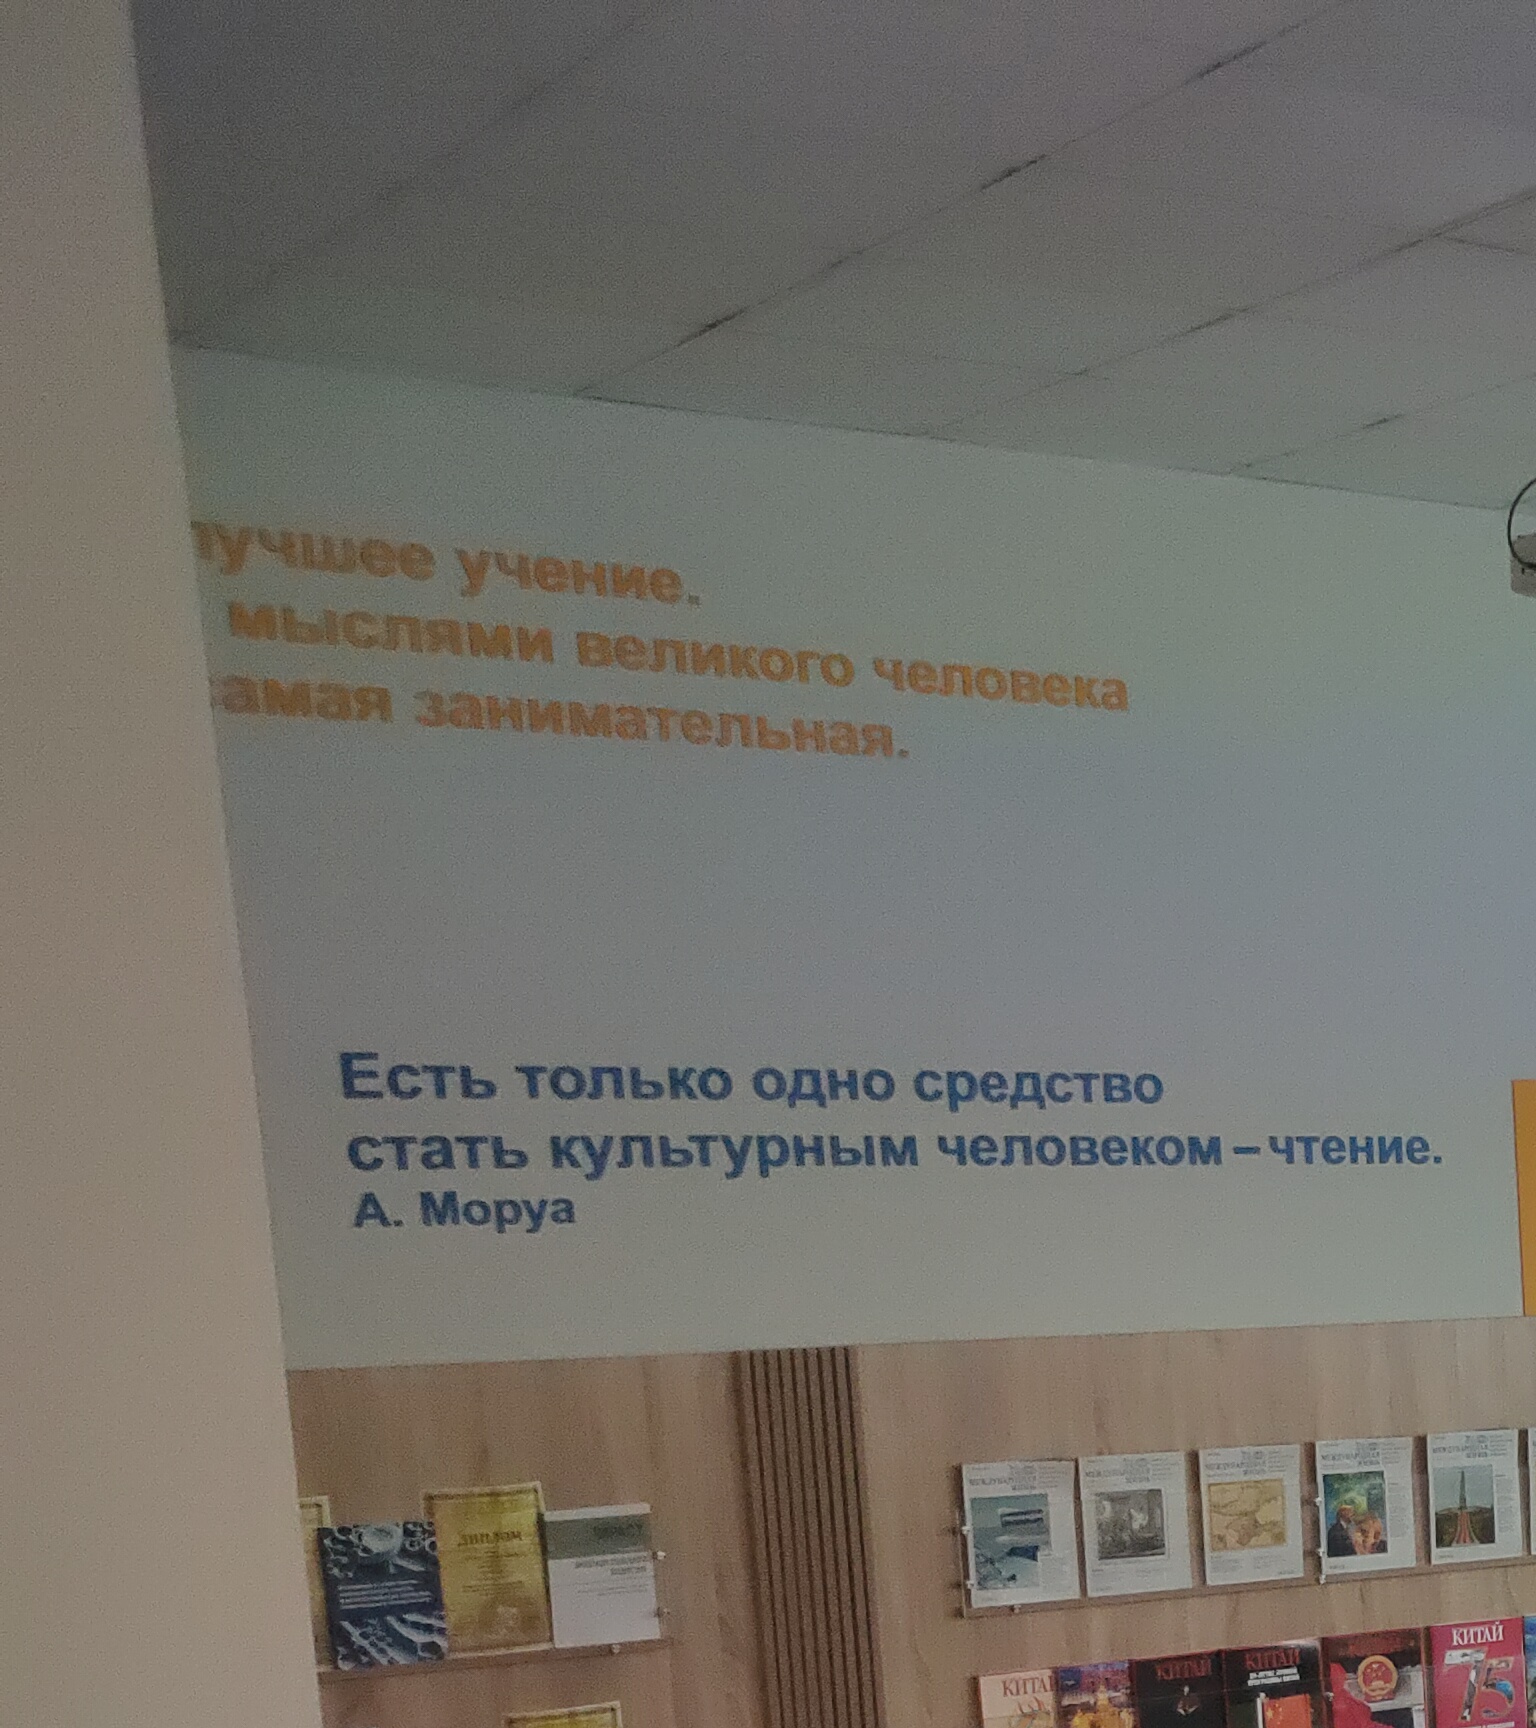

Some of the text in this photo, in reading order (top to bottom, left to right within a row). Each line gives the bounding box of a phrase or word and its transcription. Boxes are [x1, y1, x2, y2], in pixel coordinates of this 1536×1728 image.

[454, 546, 700, 606] учение.
[227, 600, 1130, 712] мыслями великого человека
[413, 686, 910, 759] занимательная.
[339, 1051, 1164, 1112] Есть только одно средство
[347, 1134, 529, 1171] стать
[550, 1134, 919, 1182] культурным
[937, 1134, 1223, 1167] человеком
[1268, 1134, 1443, 1166] чтение.
[353, 1190, 576, 1235] А. Моруа
[1452, 1621, 1504, 1646] КИТАЙ
[1444, 1648, 1515, 1722] 75
